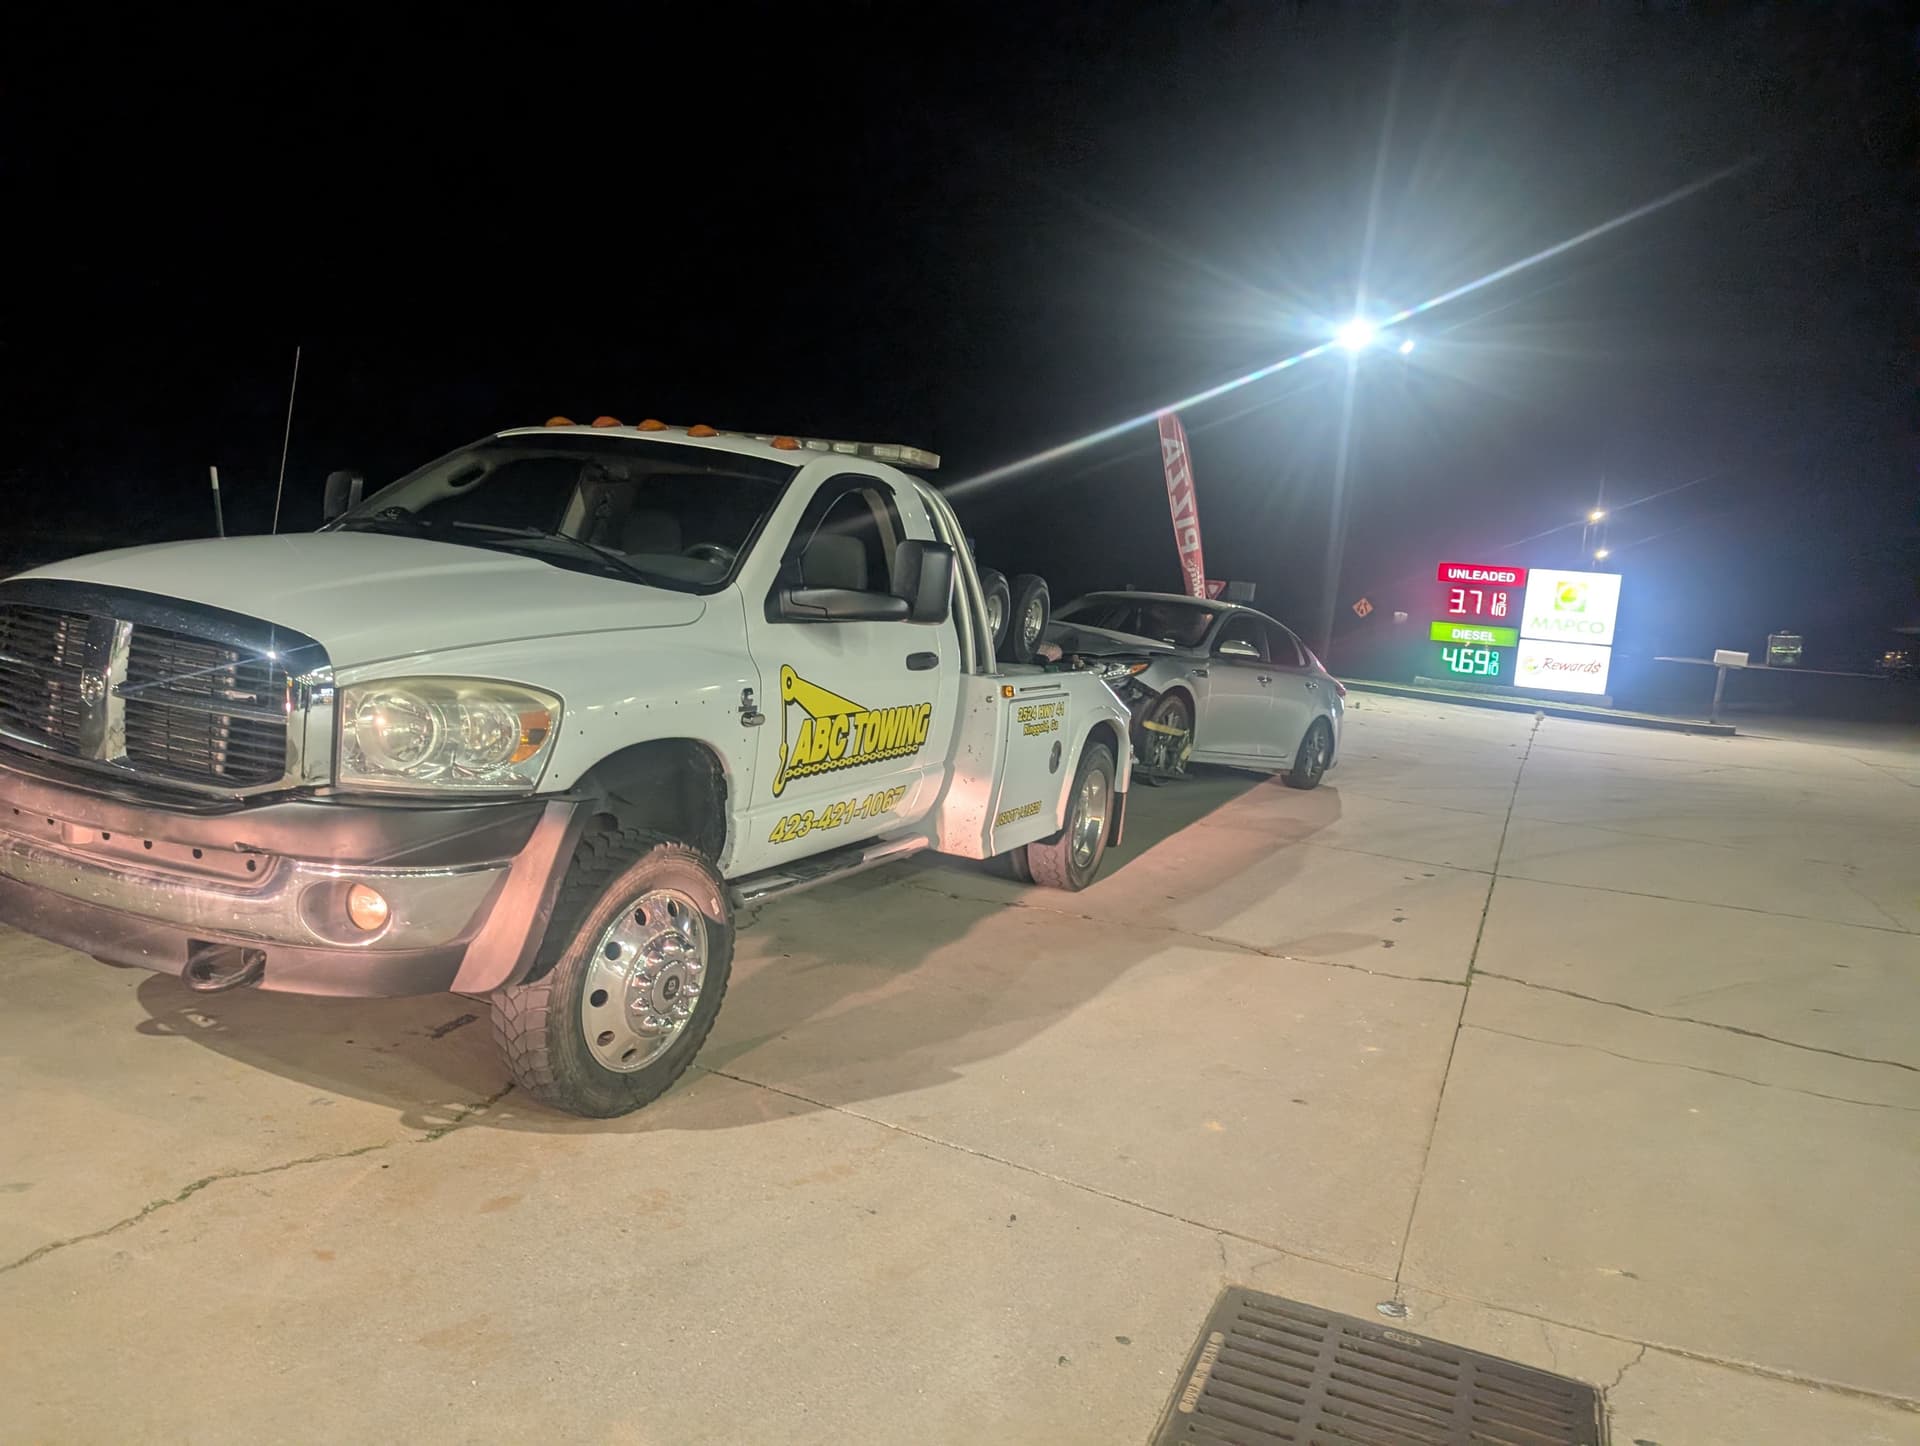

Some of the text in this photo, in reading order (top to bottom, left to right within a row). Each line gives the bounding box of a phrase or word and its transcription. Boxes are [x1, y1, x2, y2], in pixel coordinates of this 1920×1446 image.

[1447, 568, 1516, 583] UNLEADED
[1451, 628, 1496, 642] DIESEL
[1531, 617, 1605, 634] MAPCO
[1017, 705, 1037, 723] 2524
[1038, 702, 1056, 720] HWY
[789, 702, 932, 768] ABC TOWING
[768, 785, 907, 845] 423-421-1067
